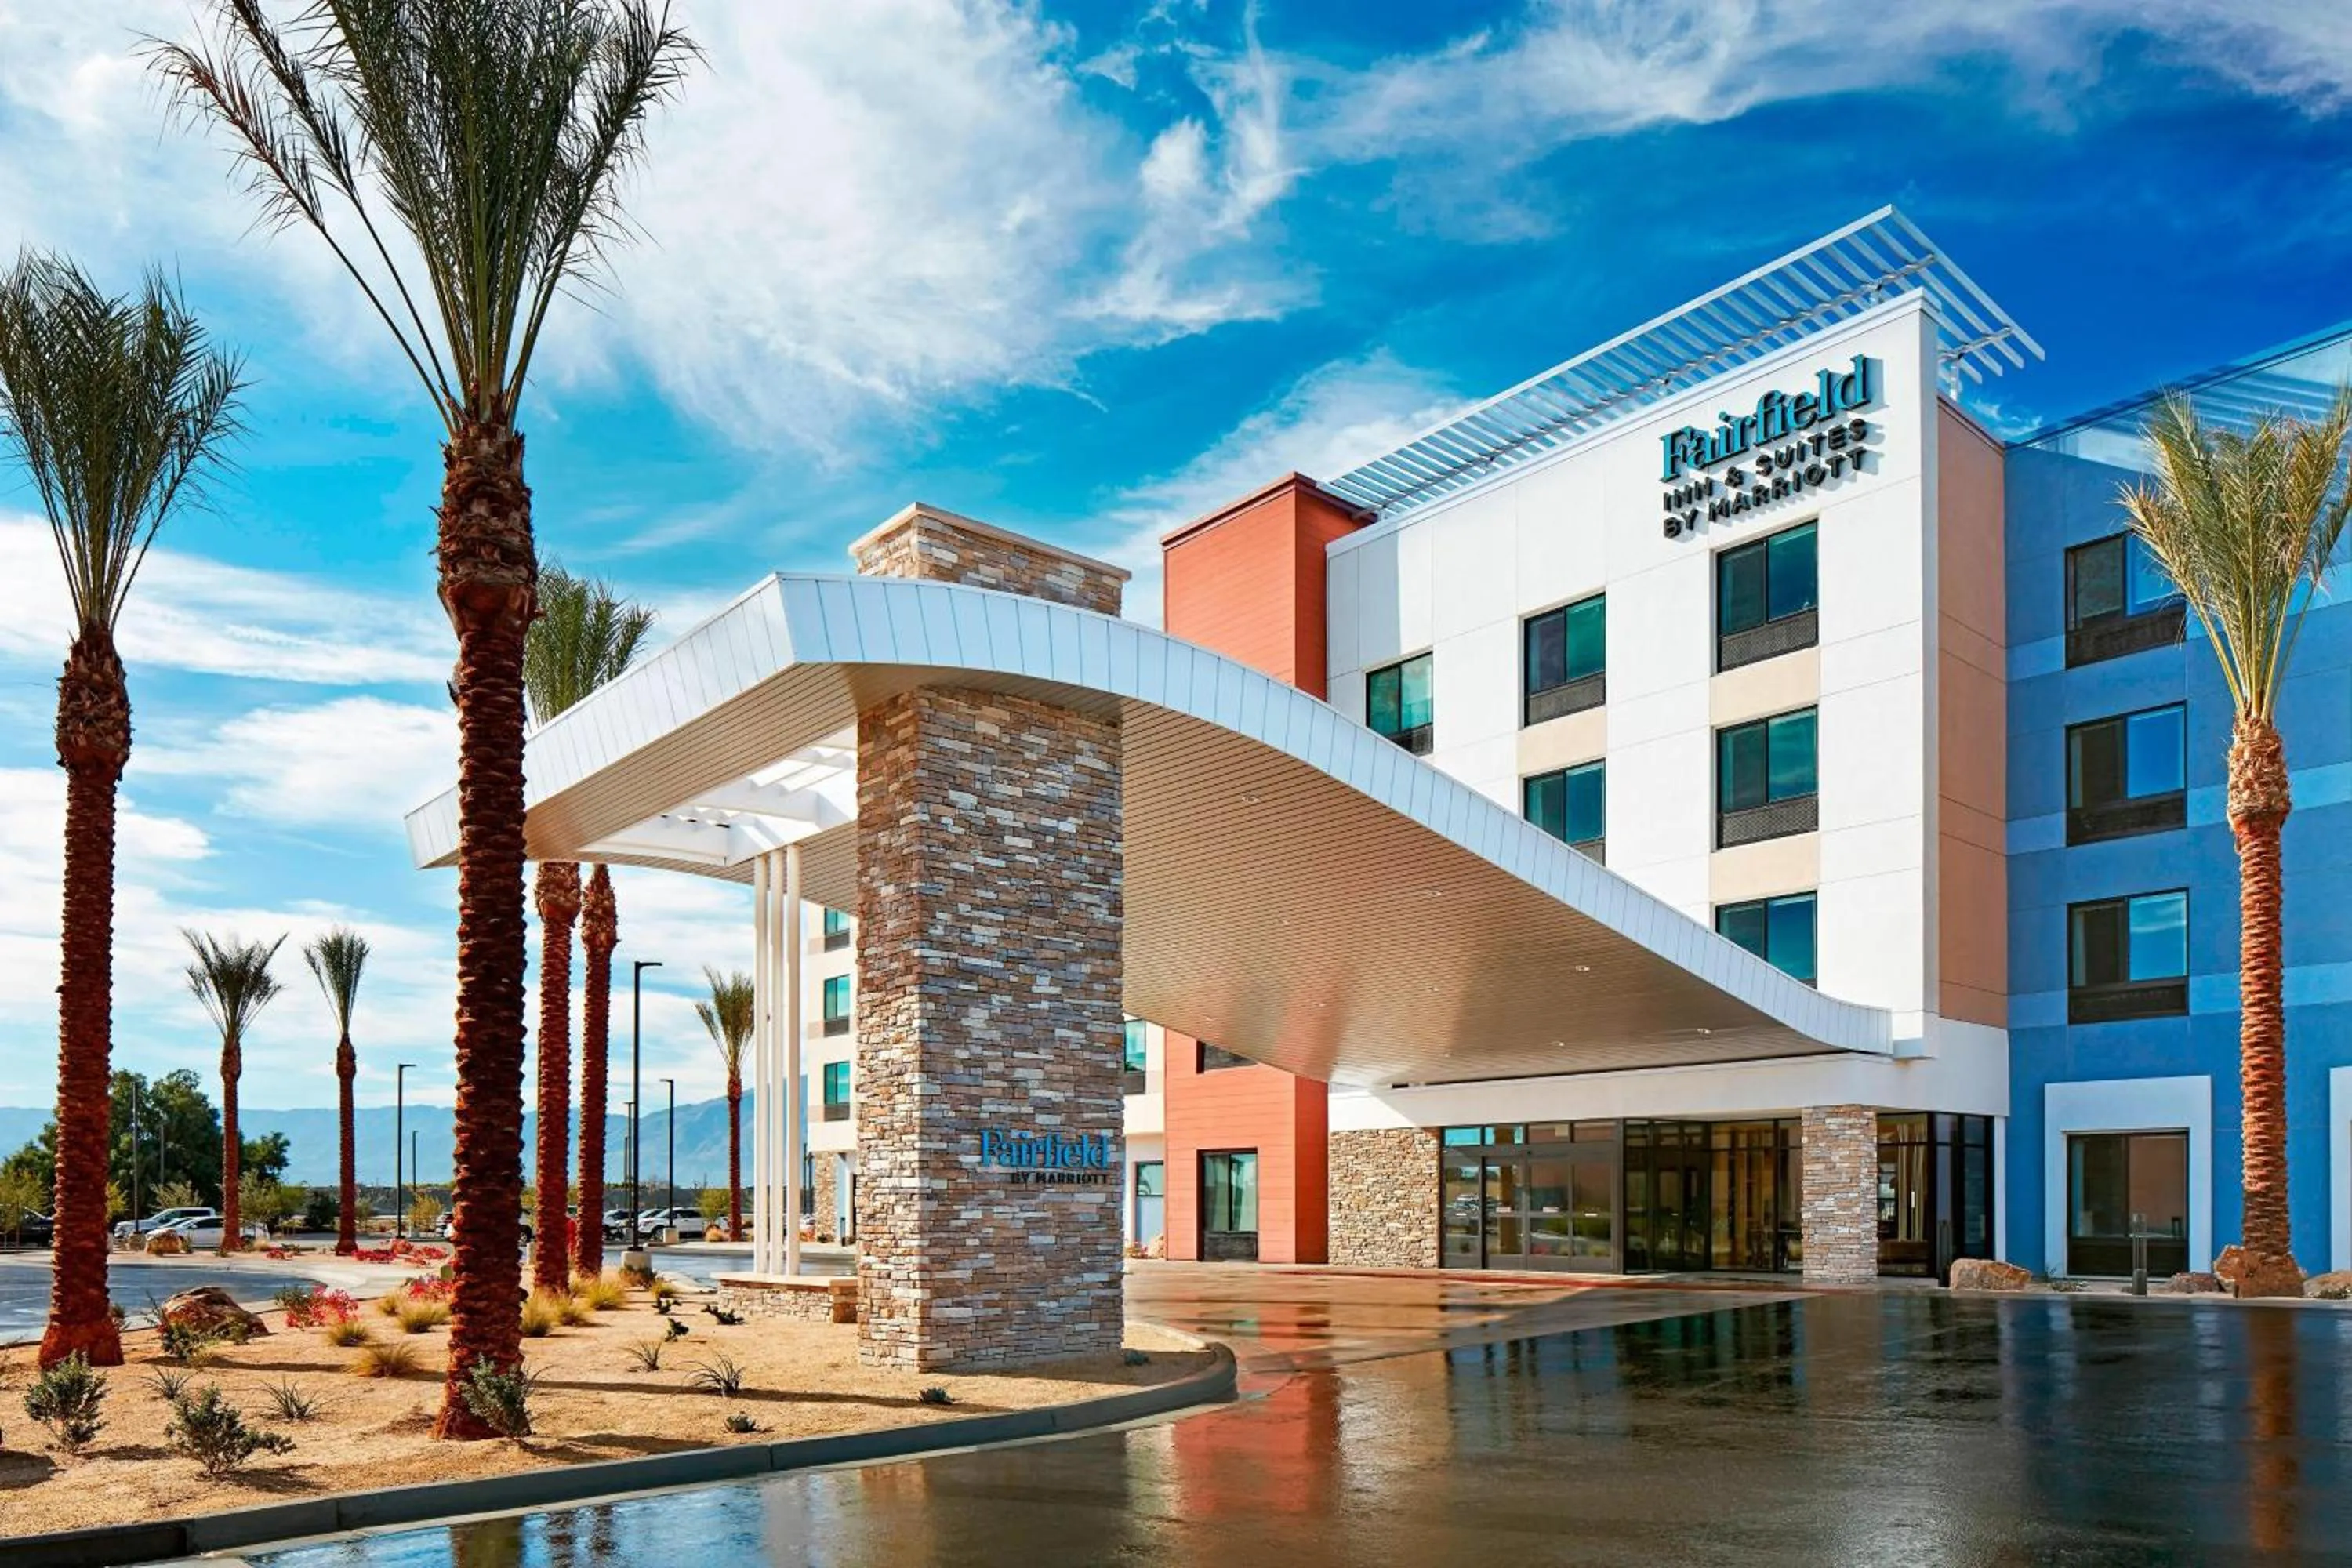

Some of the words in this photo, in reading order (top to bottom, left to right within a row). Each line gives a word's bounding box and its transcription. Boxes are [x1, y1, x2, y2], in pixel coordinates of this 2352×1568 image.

[1660, 354, 1871, 483] Fairfield
[1663, 476, 1713, 512] INN
[1725, 466, 1744, 488] &
[1755, 418, 1867, 477] SUITES
[1663, 508, 1699, 539] BY
[1708, 446, 1867, 522] MARRIOTT
[980, 1129, 1110, 1169] Fairfield
[1011, 1172, 1030, 1185] BY
[1036, 1171, 1108, 1185] MARRIOTT
